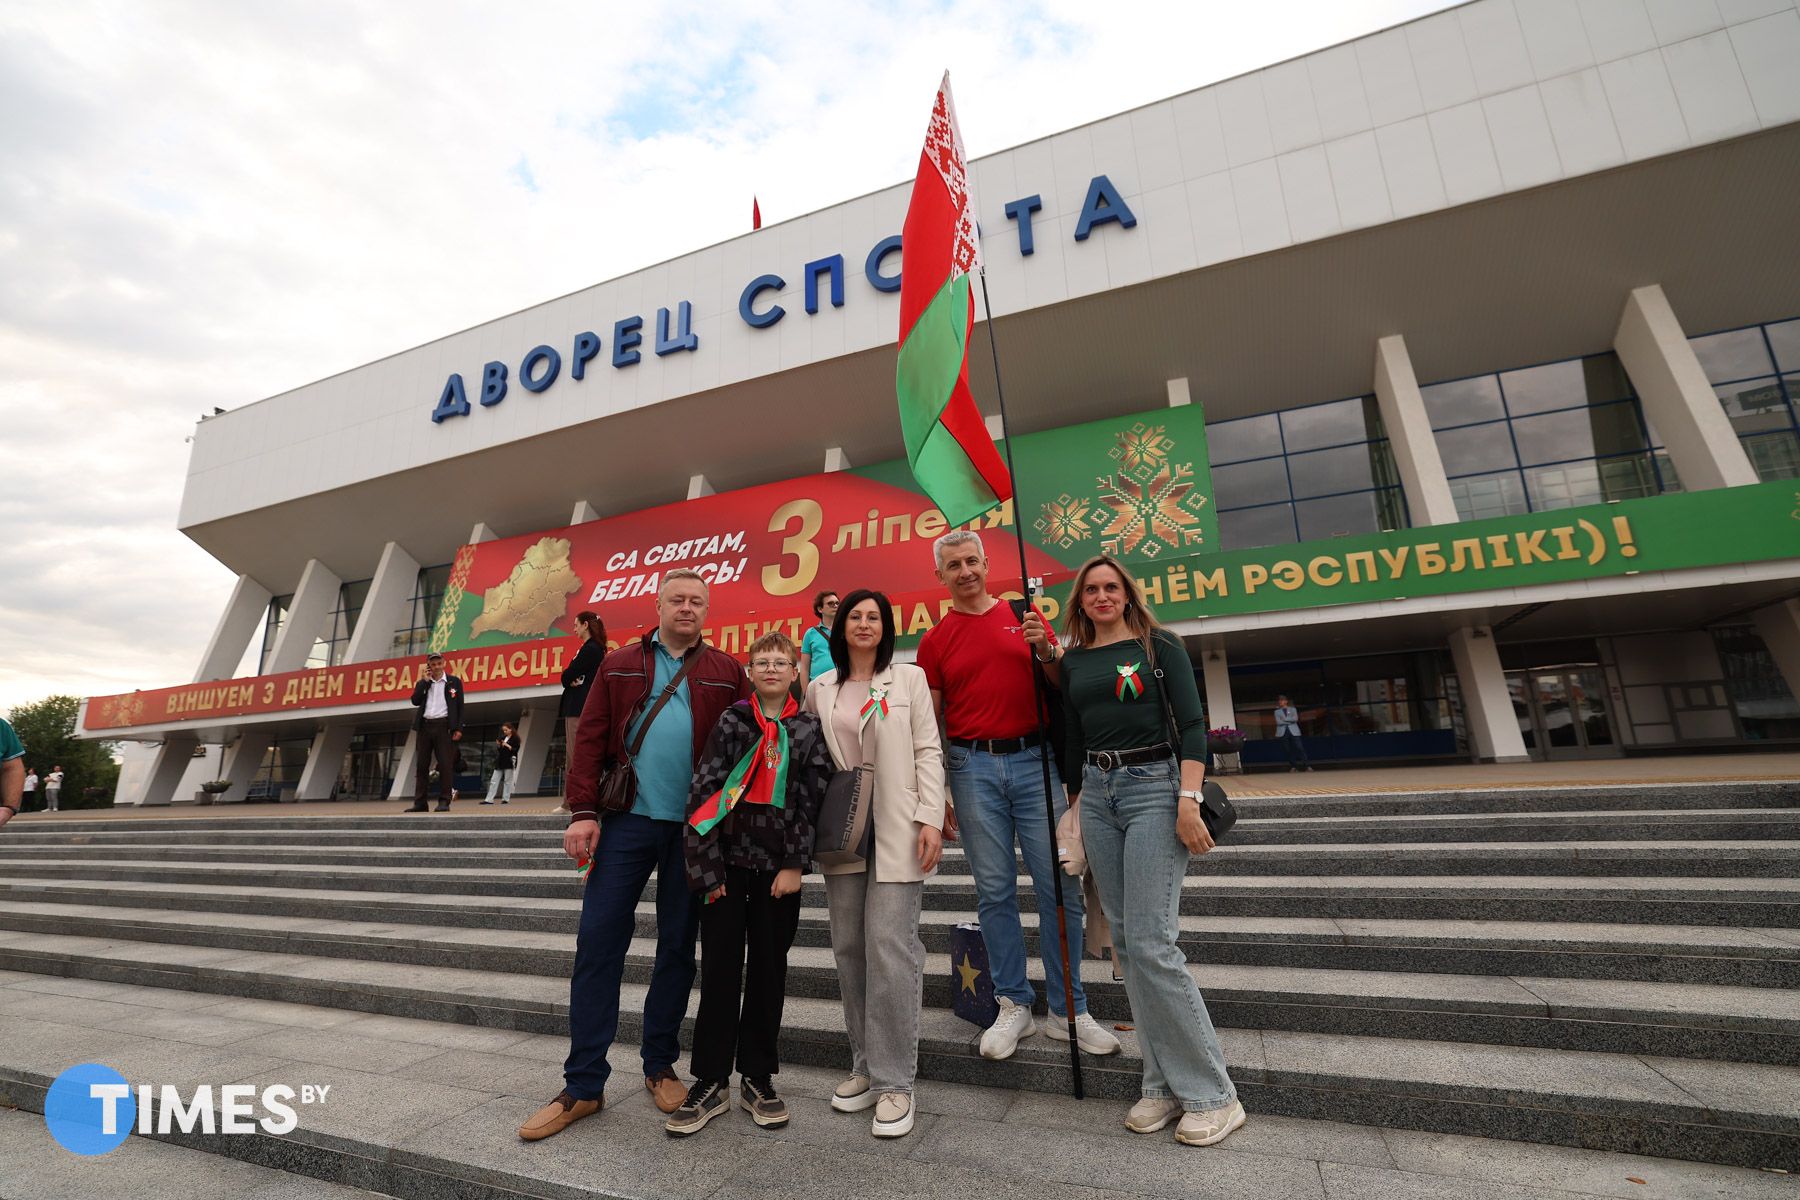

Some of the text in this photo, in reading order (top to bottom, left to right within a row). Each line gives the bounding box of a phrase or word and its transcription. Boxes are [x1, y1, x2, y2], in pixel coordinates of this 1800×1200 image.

[431, 174, 1137, 424] ДВОРЕЦ СПОТА
[588, 557, 748, 604] БЕЛАСЬ!
[606, 530, 747, 572] СА СВЯТАМ,
[761, 498, 823, 596] 3
[166, 684, 255, 714] ВІНШУЕМ
[282, 669, 344, 705] ДНЁМ
[354, 646, 564, 694] НЕЗАЖНАСЦІ
[1242, 516, 1638, 594] РЭСПУБЛІКІ)!
